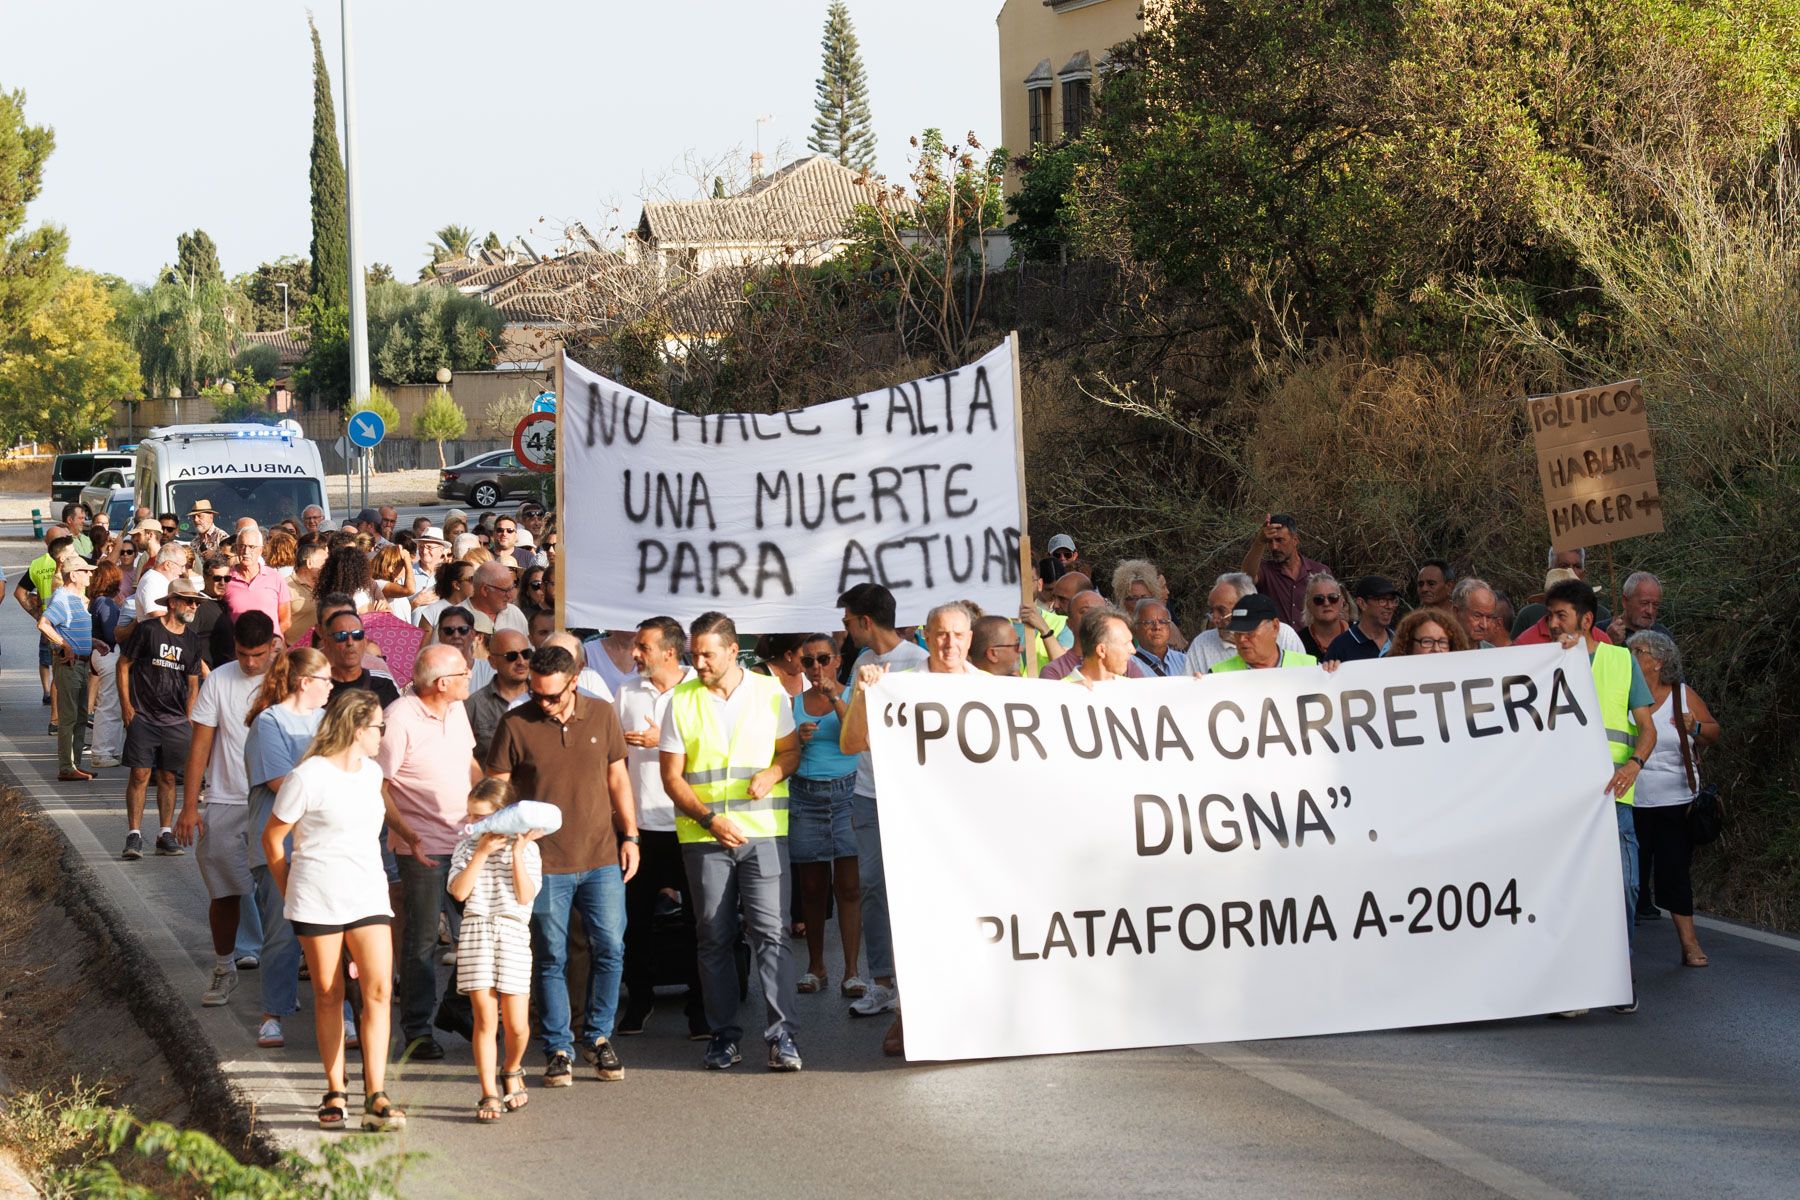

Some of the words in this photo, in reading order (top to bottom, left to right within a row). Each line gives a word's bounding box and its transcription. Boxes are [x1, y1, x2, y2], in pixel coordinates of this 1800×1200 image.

[586, 382, 650, 447] NO
[851, 365, 998, 435] FALTA
[624, 469, 716, 531] UNA
[755, 463, 978, 530] MUERTE
[636, 539, 795, 599] PARA
[159, 643, 183, 661] CAT
[1060, 704, 1194, 761] UNA
[1207, 667, 1588, 761] CARRETERA
[1353, 878, 1536, 938] A-2004.
